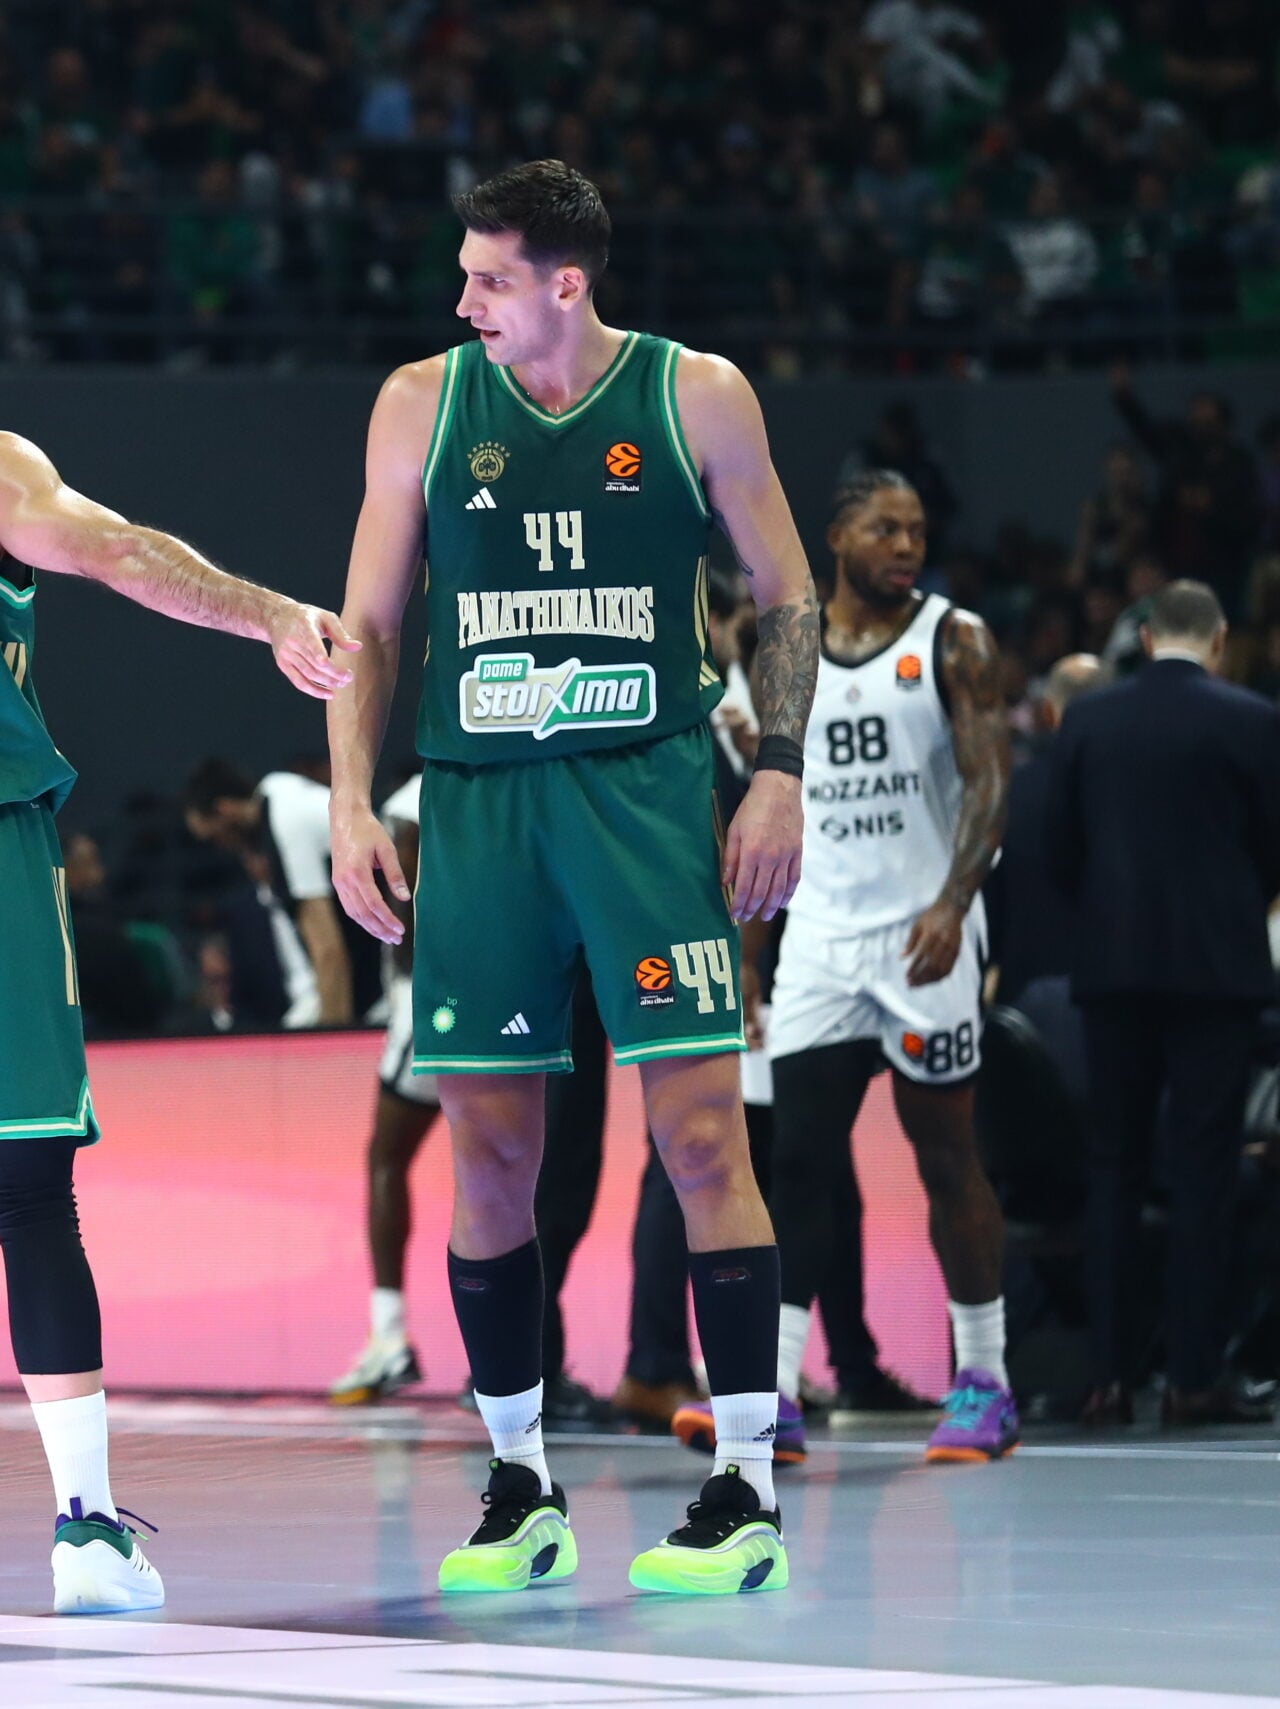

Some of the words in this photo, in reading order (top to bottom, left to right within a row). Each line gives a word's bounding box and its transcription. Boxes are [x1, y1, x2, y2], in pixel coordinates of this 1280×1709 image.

[523, 510, 585, 571] 44
[457, 587, 655, 649] PANATHINAIKOS
[482, 661, 523, 680] pame
[826, 716, 889, 766] 88
[854, 811, 904, 837] NIS
[447, 997, 458, 1006] bp
[671, 938, 736, 1014] 44
[926, 1021, 974, 1074] 88
